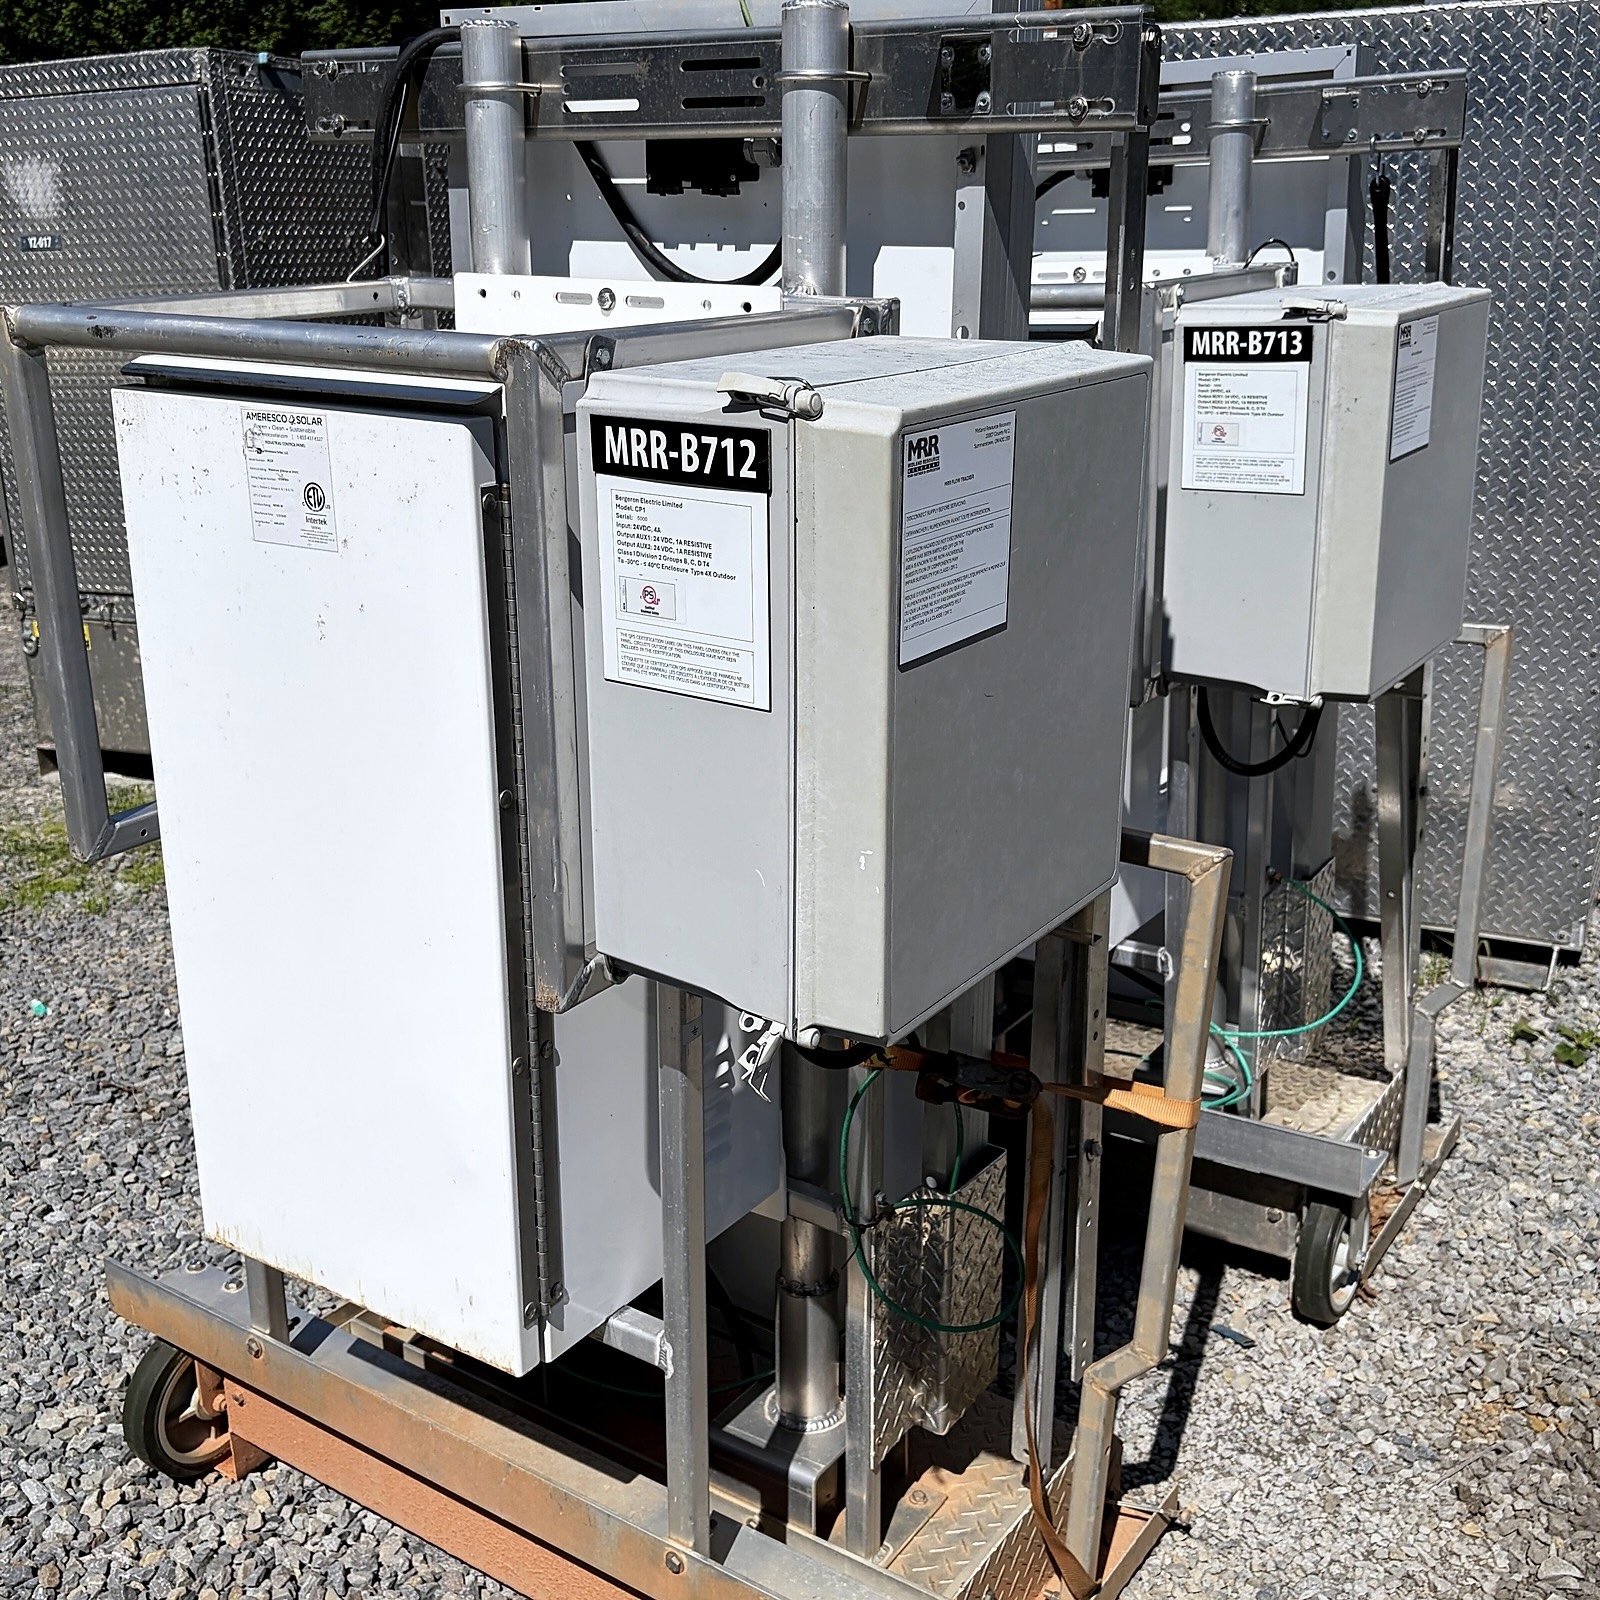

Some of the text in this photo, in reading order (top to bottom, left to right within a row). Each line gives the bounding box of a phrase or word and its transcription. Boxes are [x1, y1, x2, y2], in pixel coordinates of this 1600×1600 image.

[1192, 330, 1302, 356] MRR-B713
[245, 412, 323, 426] AMERESCO SOLAR
[605, 426, 757, 479] MRR-B712
[908, 435, 940, 462] MRR
[640, 498, 661, 507] Electric
[662, 500, 683, 510] Limited
[306, 516, 328, 526] Intertek
[616, 530, 636, 539] Output
[660, 536, 675, 545] VDC,
[684, 540, 712, 550] RESISTIVE
[617, 539, 636, 548] Output
[661, 546, 675, 554] VDC,
[684, 549, 712, 559] RESISTIVE
[617, 548, 632, 557] Class
[662, 555, 682, 564] Groups
[661, 563, 688, 573] Enclosure
[691, 568, 704, 578] Type
[712, 571, 736, 581] Outdoor
